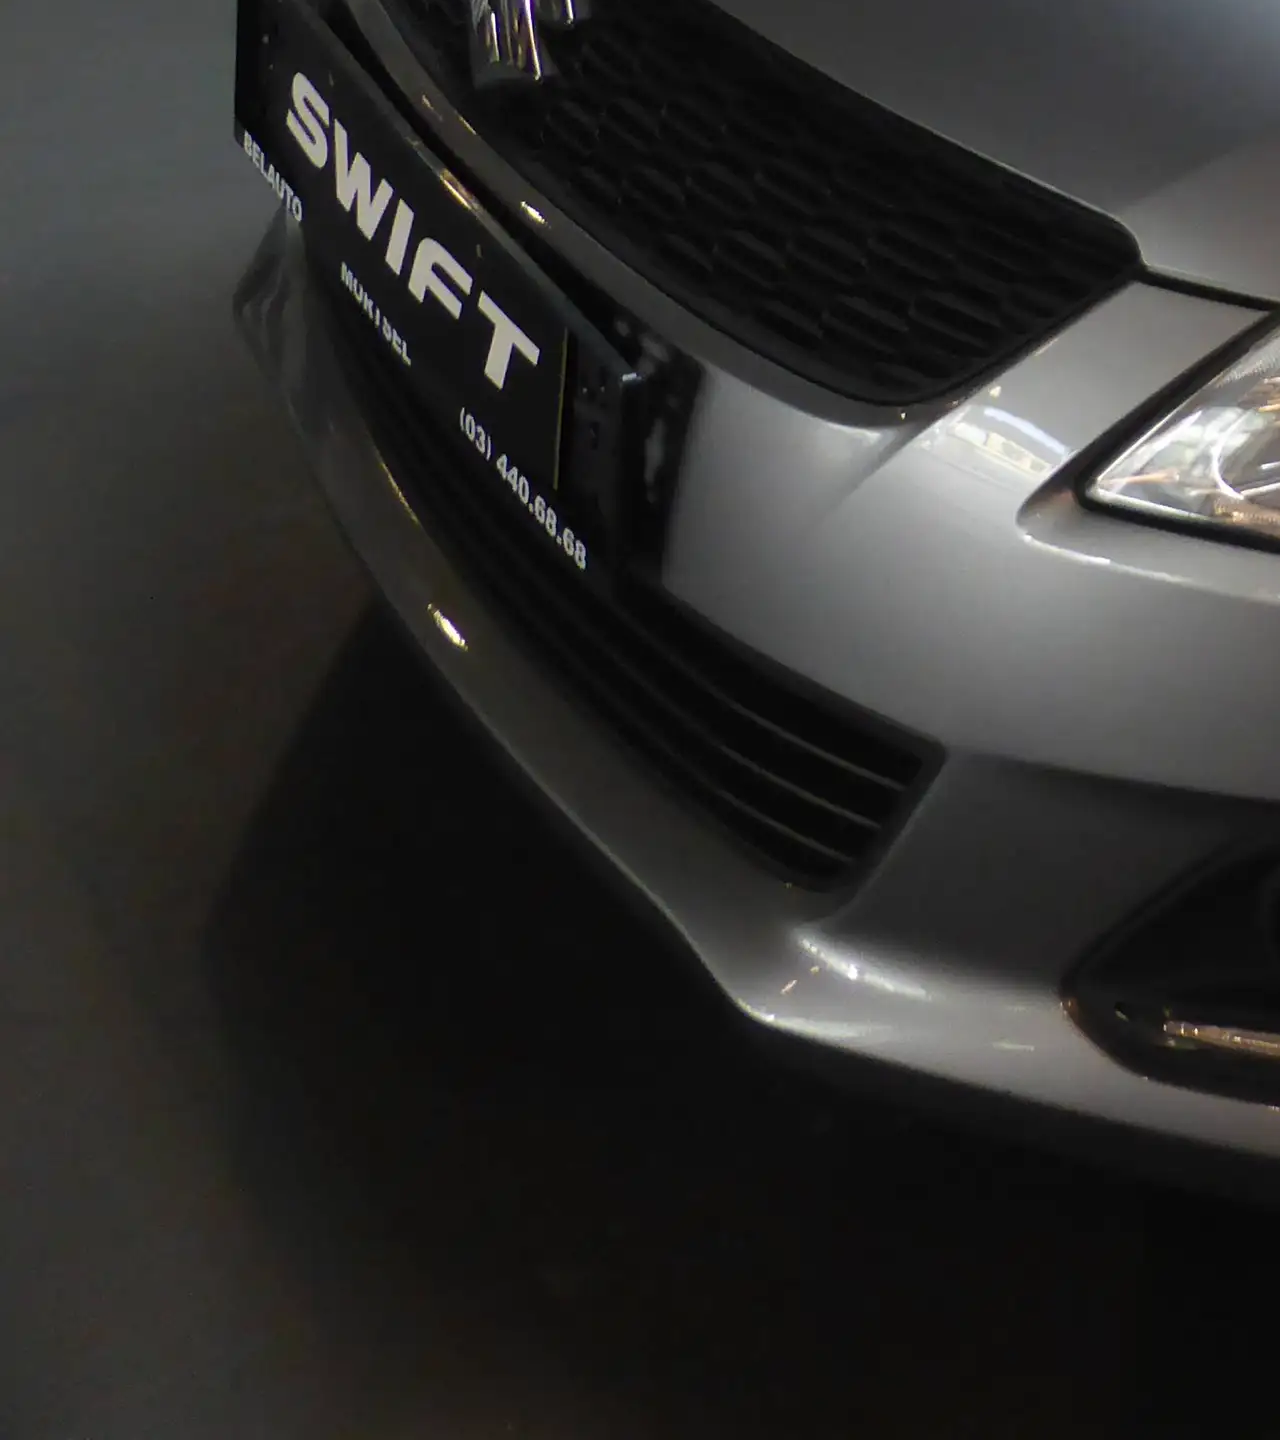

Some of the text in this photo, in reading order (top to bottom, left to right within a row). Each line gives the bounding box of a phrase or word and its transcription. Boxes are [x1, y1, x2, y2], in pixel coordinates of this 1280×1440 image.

[243, 129, 303, 223] BELAUTO
[285, 71, 541, 391] SWIFT
[459, 406, 587, 571] (03) 440.68.68
